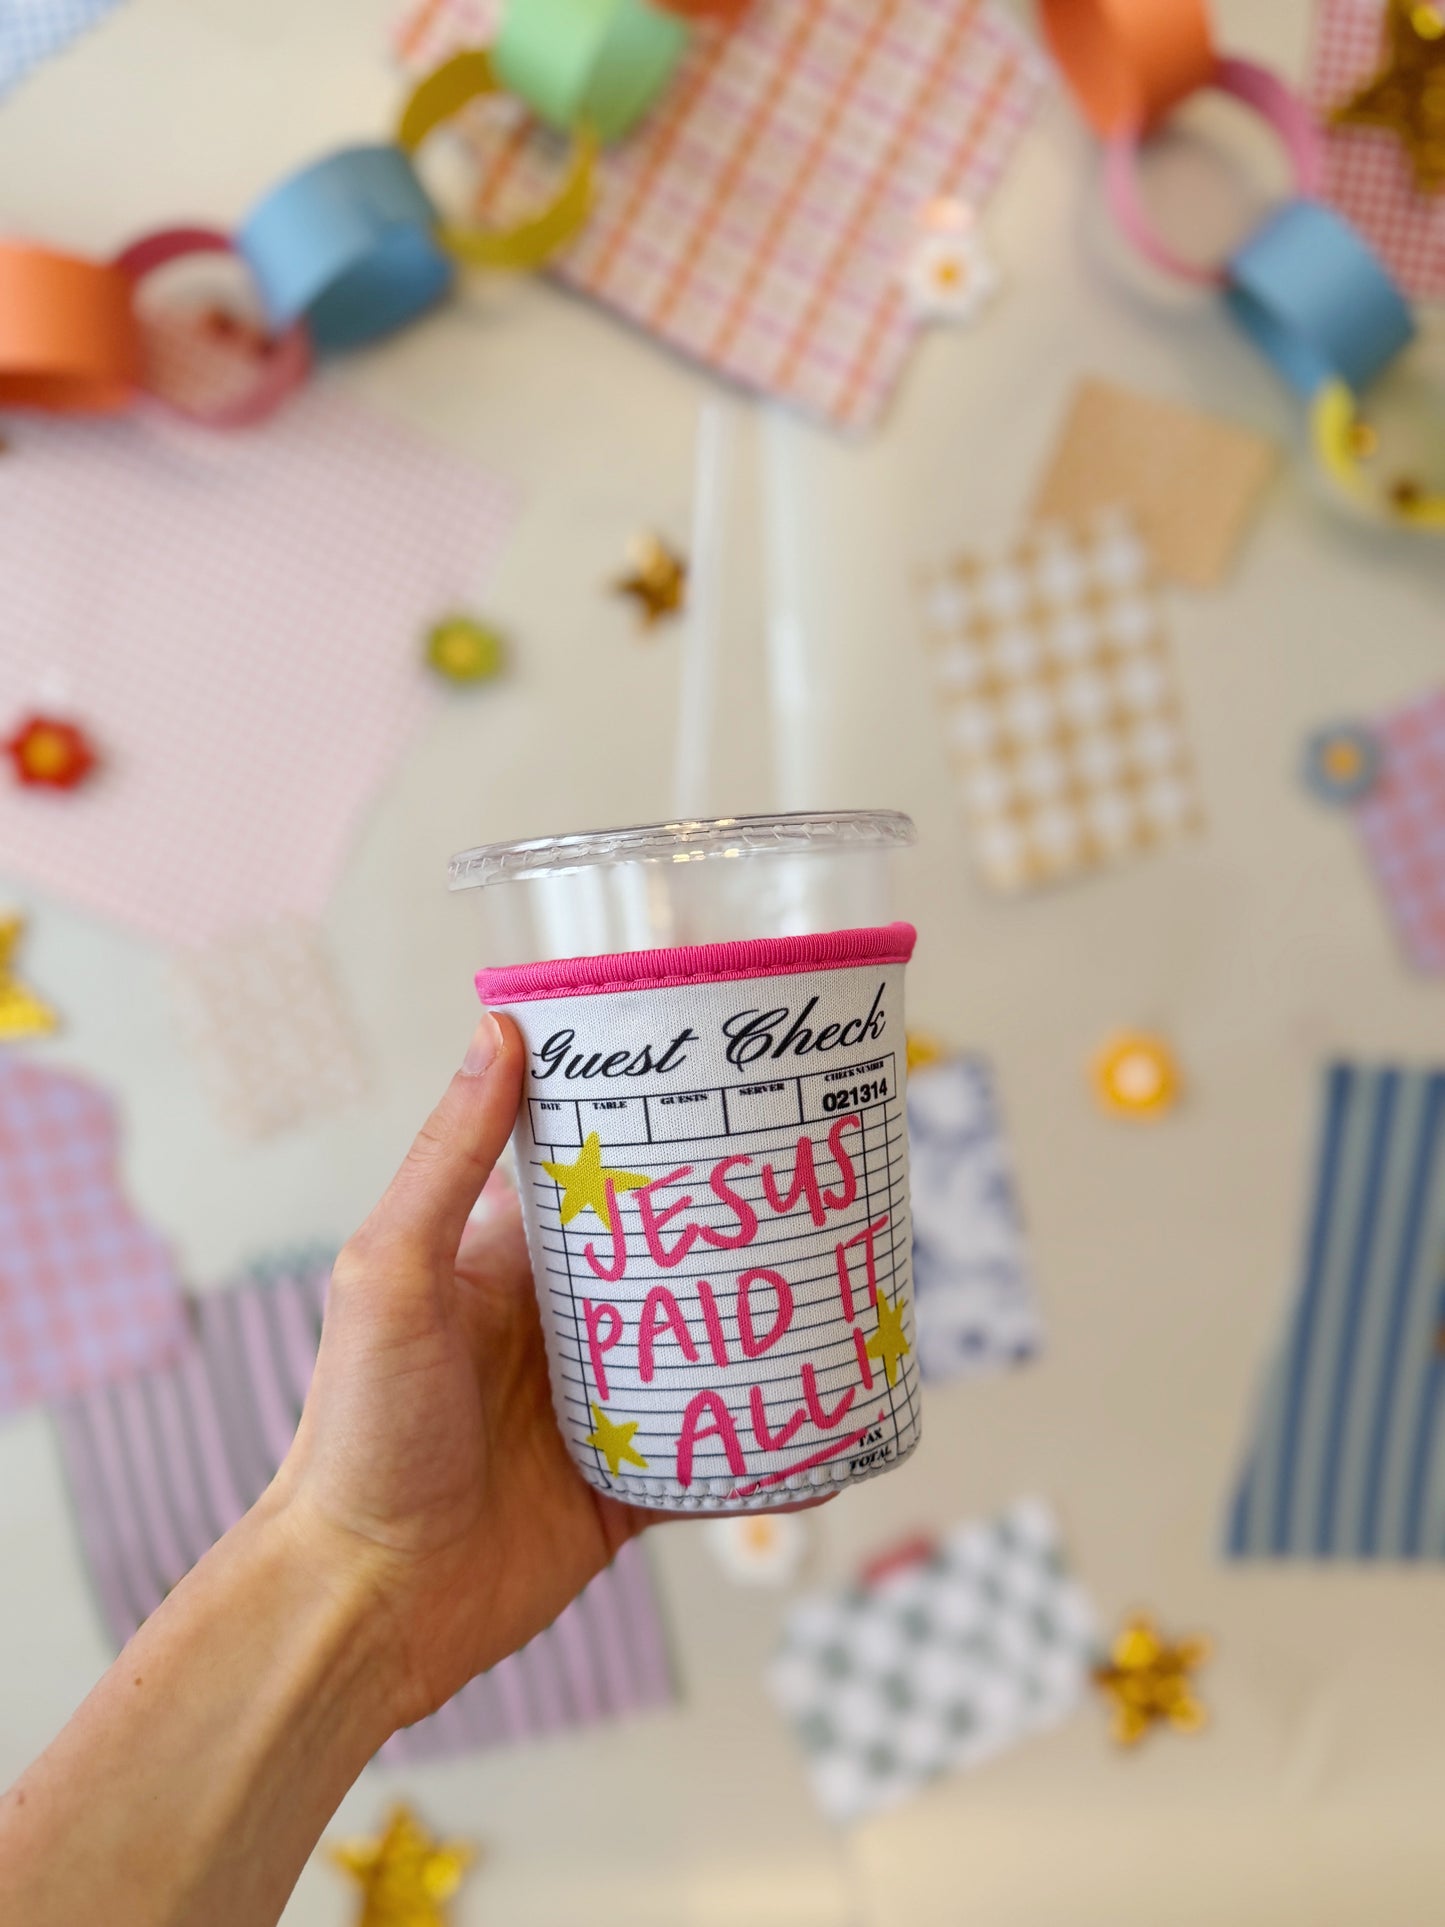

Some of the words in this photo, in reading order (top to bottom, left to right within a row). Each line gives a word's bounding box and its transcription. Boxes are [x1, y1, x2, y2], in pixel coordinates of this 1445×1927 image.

[531, 1029, 699, 1081] Guest
[722, 982, 887, 1073] Check
[824, 1068, 855, 1082] CHECK
[856, 1060, 884, 1075] NUMBER
[660, 1093, 708, 1106] GUESTS
[739, 1082, 785, 1097] SERVER
[822, 1077, 888, 1112] 021314
[540, 1102, 562, 1111] DATE
[592, 1100, 628, 1111] TABLE
[583, 1114, 861, 1283] JESUS
[582, 1268, 794, 1401] PAID
[836, 1214, 889, 1323] IT
[859, 1426, 883, 1447] TAX
[849, 1444, 893, 1470] TOTAL
